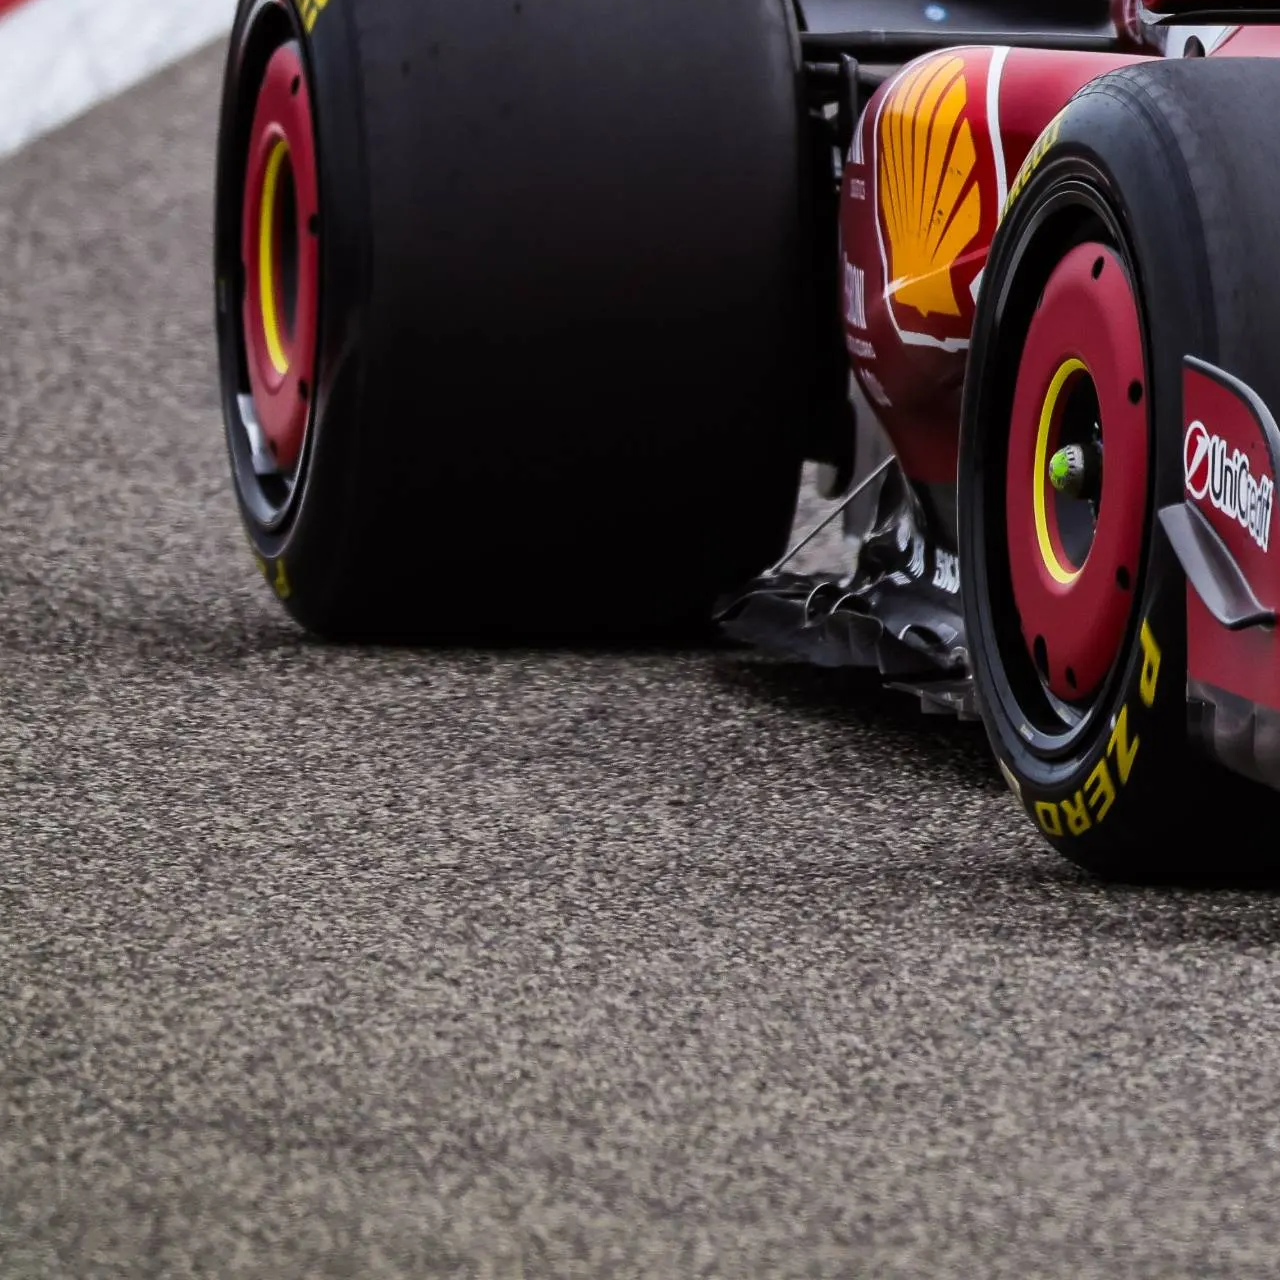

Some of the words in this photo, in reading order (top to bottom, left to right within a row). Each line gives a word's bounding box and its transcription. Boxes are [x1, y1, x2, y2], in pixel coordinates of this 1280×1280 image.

[1209, 437, 1273, 550] UniCredit
[1140, 617, 1162, 709] P
[1034, 703, 1140, 837] ZERO
